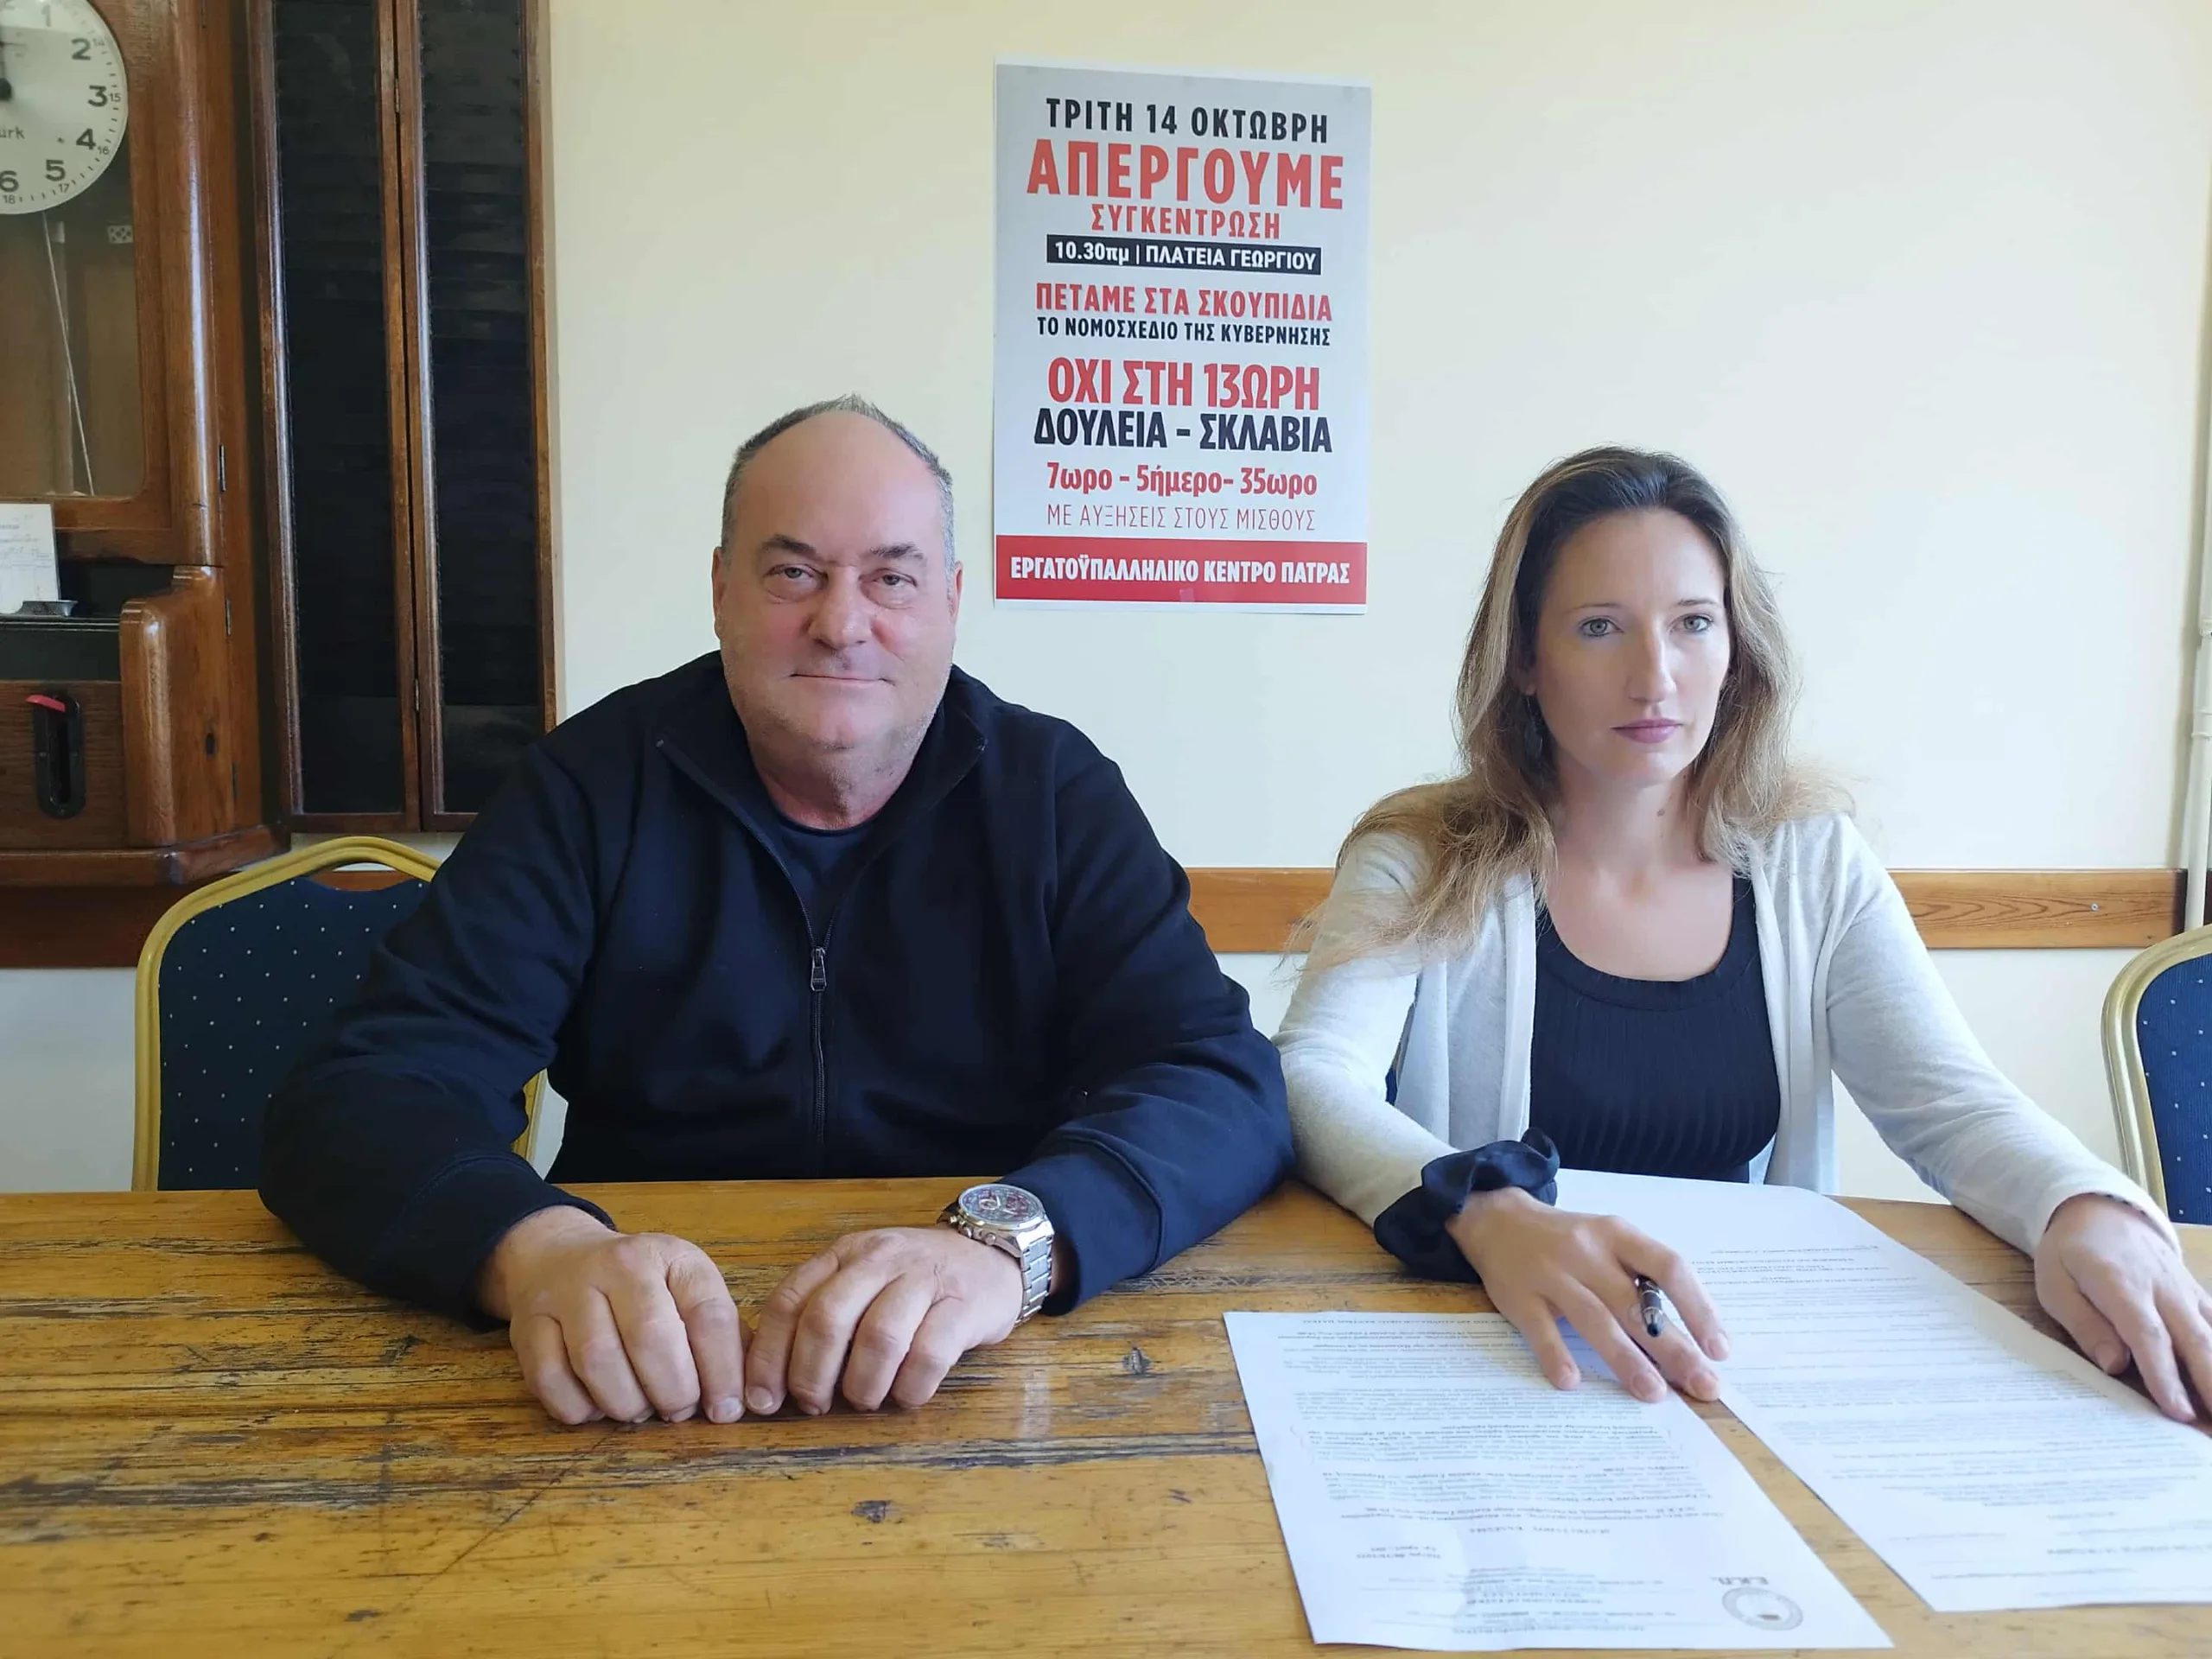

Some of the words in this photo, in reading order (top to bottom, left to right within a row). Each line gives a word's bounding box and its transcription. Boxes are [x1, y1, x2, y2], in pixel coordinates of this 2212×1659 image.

[71, 38, 91, 60] 2
[87, 85, 108, 107] 3
[109, 92, 121, 102] 15
[1046, 98, 1132, 131] ΤΡΙΤΗ
[1147, 104, 1178, 134] 14
[1192, 106, 1327, 143] ΟΚΤΩΒΡΗ
[75, 128, 96, 150] 4
[97, 145, 110, 156] 16
[0, 170, 19, 193] 6
[45, 159, 66, 181] 5
[1027, 138, 1344, 210] ΑΠΕΡΓΟΥΜΕ
[3, 194, 16, 205] 18
[58, 182, 70, 193] 17
[1090, 203, 1280, 239] ΣΥΓΚΕΝΤΡΩΣΗ
[1054, 241, 1129, 266] 10.30πμ
[1146, 245, 1225, 267] ΠΛΑΤΕΙΑ
[1230, 249, 1317, 271] ΓΕΩΡΓΙΟΥ
[1036, 282, 1135, 314] ΠΕΤΑΜΕ
[1144, 286, 1190, 316] ΣΤΑ
[1198, 289, 1332, 322] ΣΚΟΥΠΙΔΙΑ
[1037, 315, 1059, 337] ΤΟ
[1065, 318, 1179, 341] ΝΟΜΟΣΧΕΔΙΟ
[1184, 322, 1216, 342] ΤΗΣ
[1221, 324, 1332, 346] ΚΥΒΕΡΝΗΣΗΣ
[1047, 356, 1112, 405] ΟΧΙ
[1122, 359, 1193, 407] ΣΤΗ
[1203, 362, 1320, 411] 13ΩΡΗ
[1033, 407, 1168, 448] ΔΟΥΛΕΙΑ
[1198, 412, 1333, 454] ΣΚΛΑΒΙΑ
[1046, 461, 1113, 495] 7ωρο
[1239, 467, 1318, 499] 35ωρο
[1047, 504, 1072, 526] ΜΕ
[1079, 504, 1166, 528] ΑΥΞΗΣΕΙΣ
[1174, 506, 1229, 530] ΣΤΟΥΣ
[1236, 508, 1316, 531] ΜΙΣΘΟΥΣ
[1010, 553, 1199, 583] ΕΡΓΑΤΟΫΠΑΛΛΗΛΙΚΟ
[1204, 559, 1276, 584] ΚΕΝΤΡΟ
[1281, 561, 1351, 585] ΠΑΤΡΑΣ
